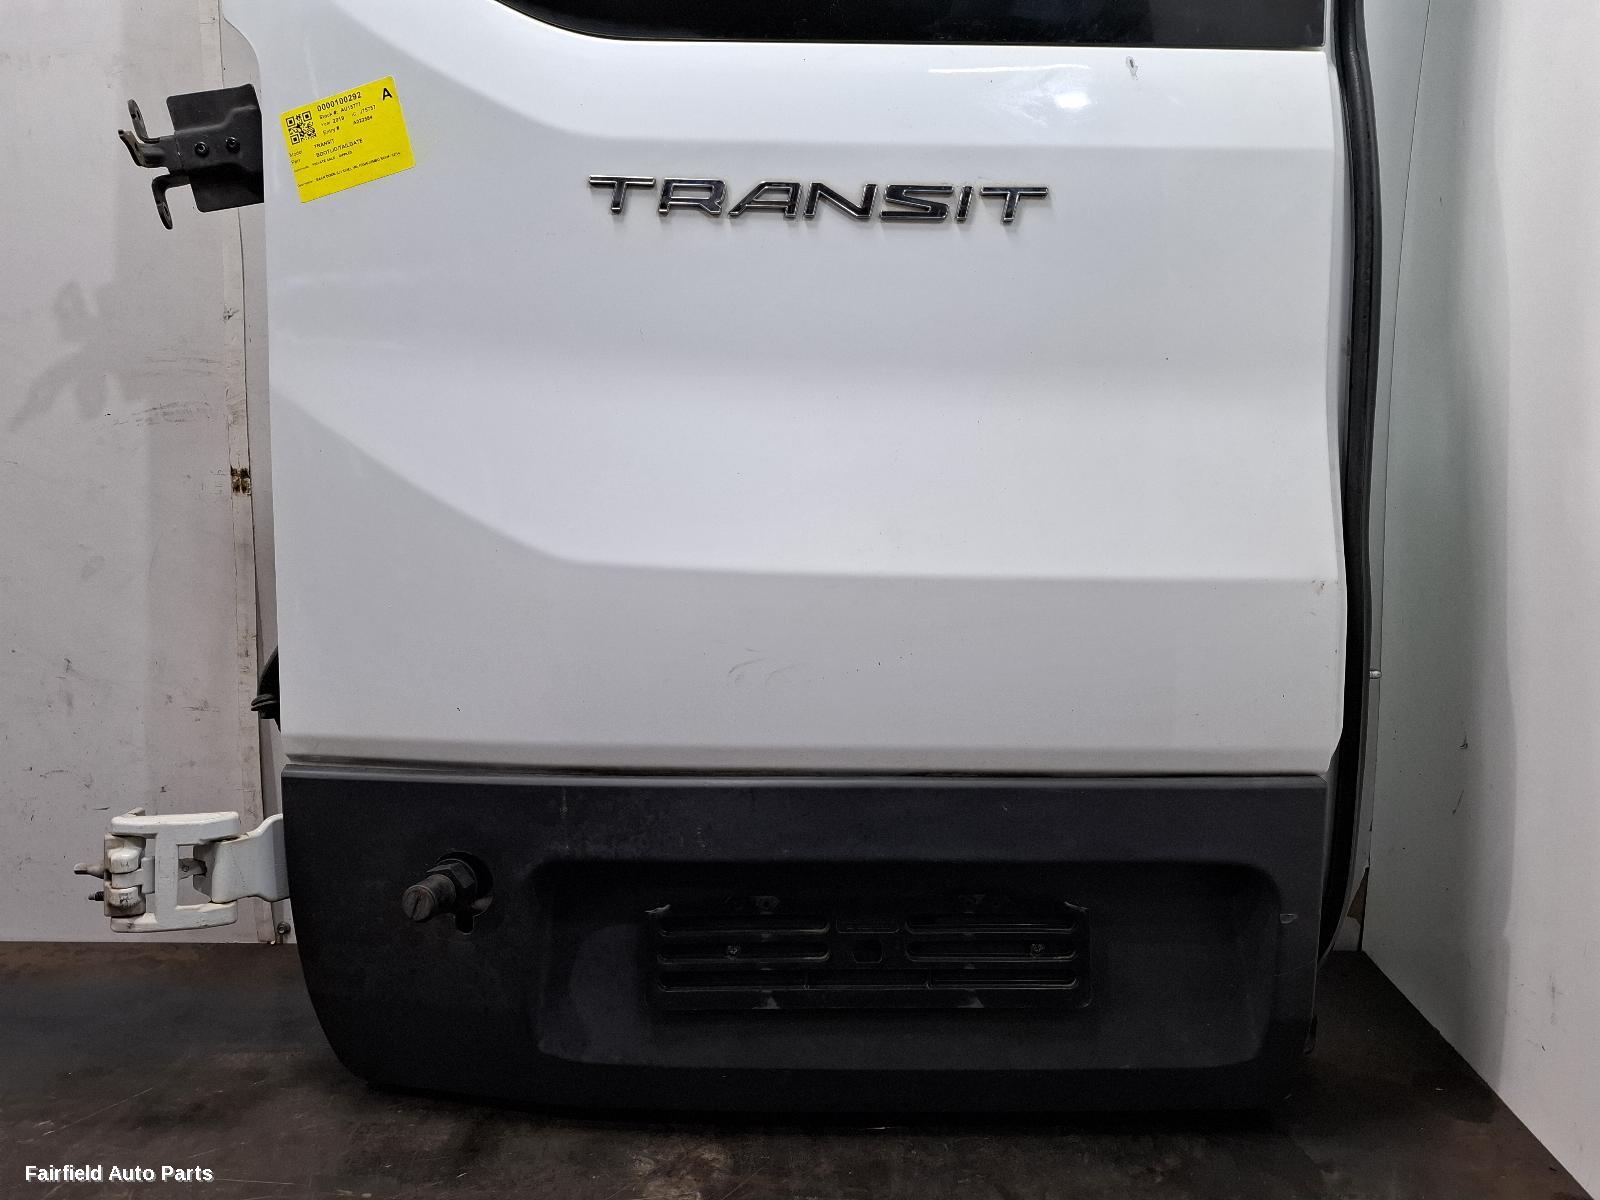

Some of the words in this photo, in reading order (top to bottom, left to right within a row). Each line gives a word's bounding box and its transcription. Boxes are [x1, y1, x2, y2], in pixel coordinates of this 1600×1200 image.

[316, 91, 362, 112] 0000100292
[382, 87, 393, 101] A
[588, 174, 1050, 224] TRANSIT
